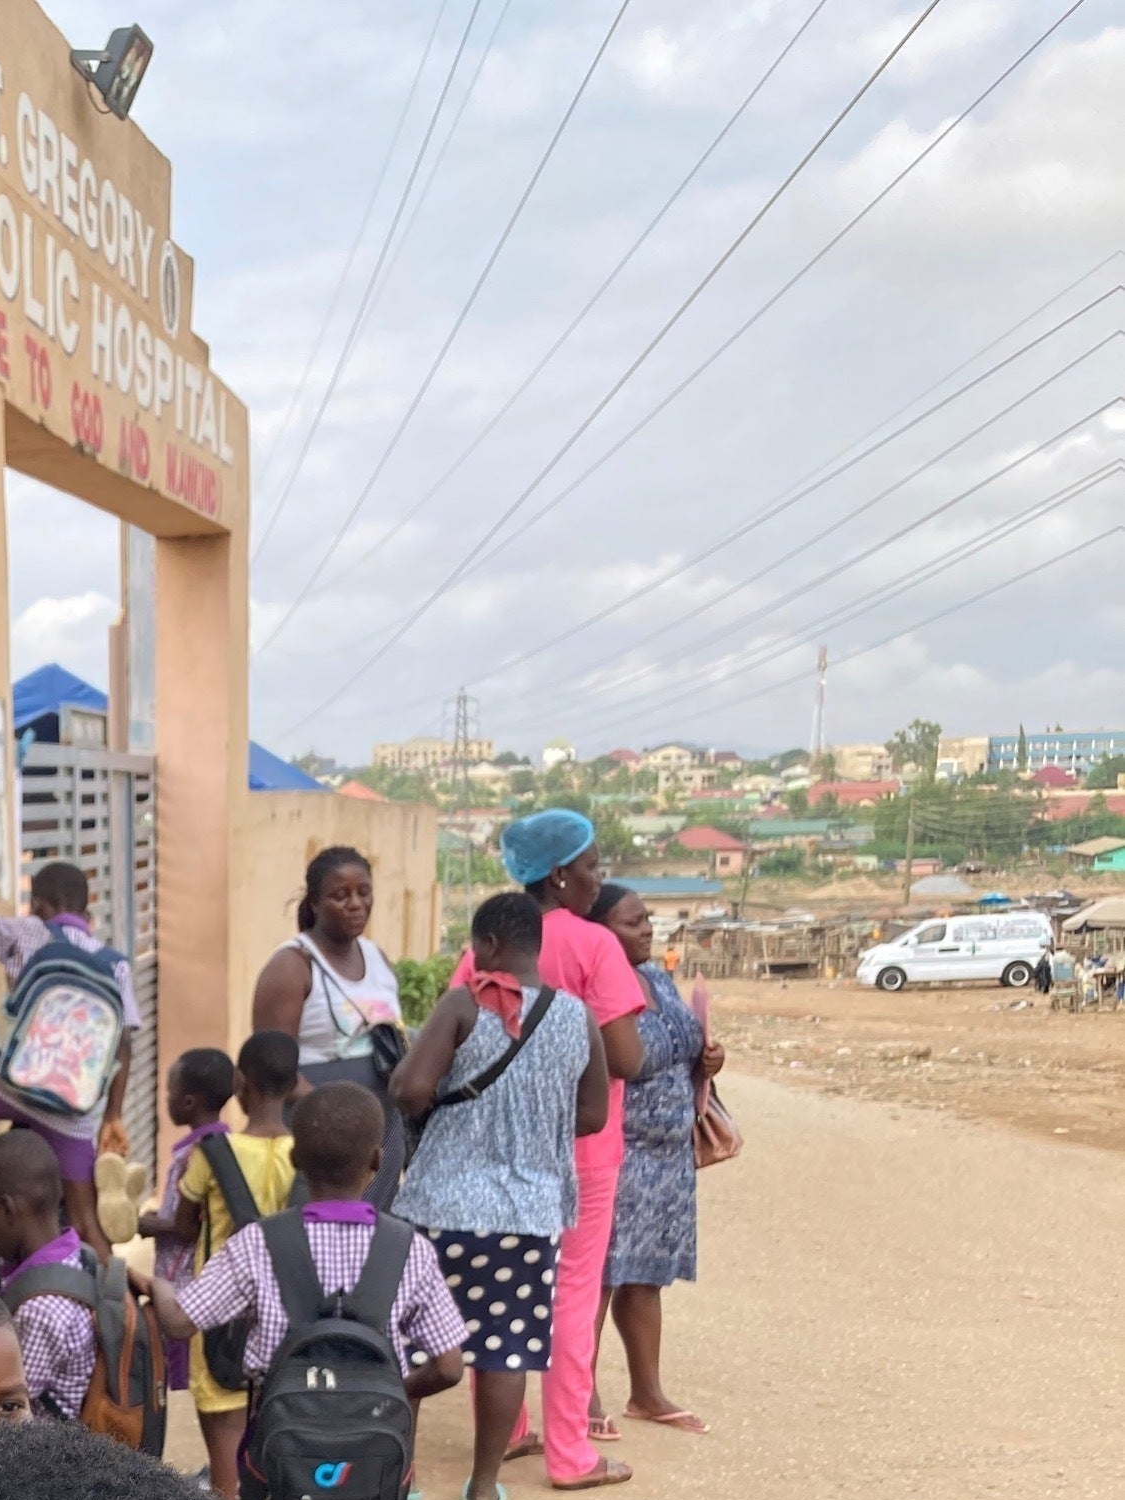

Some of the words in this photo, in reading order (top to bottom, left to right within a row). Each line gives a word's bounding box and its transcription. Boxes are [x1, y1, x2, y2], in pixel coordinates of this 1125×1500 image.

[16, 92, 156, 299] GREGORY
[25, 335, 52, 410] TO
[91, 284, 234, 467] HOSPITAL
